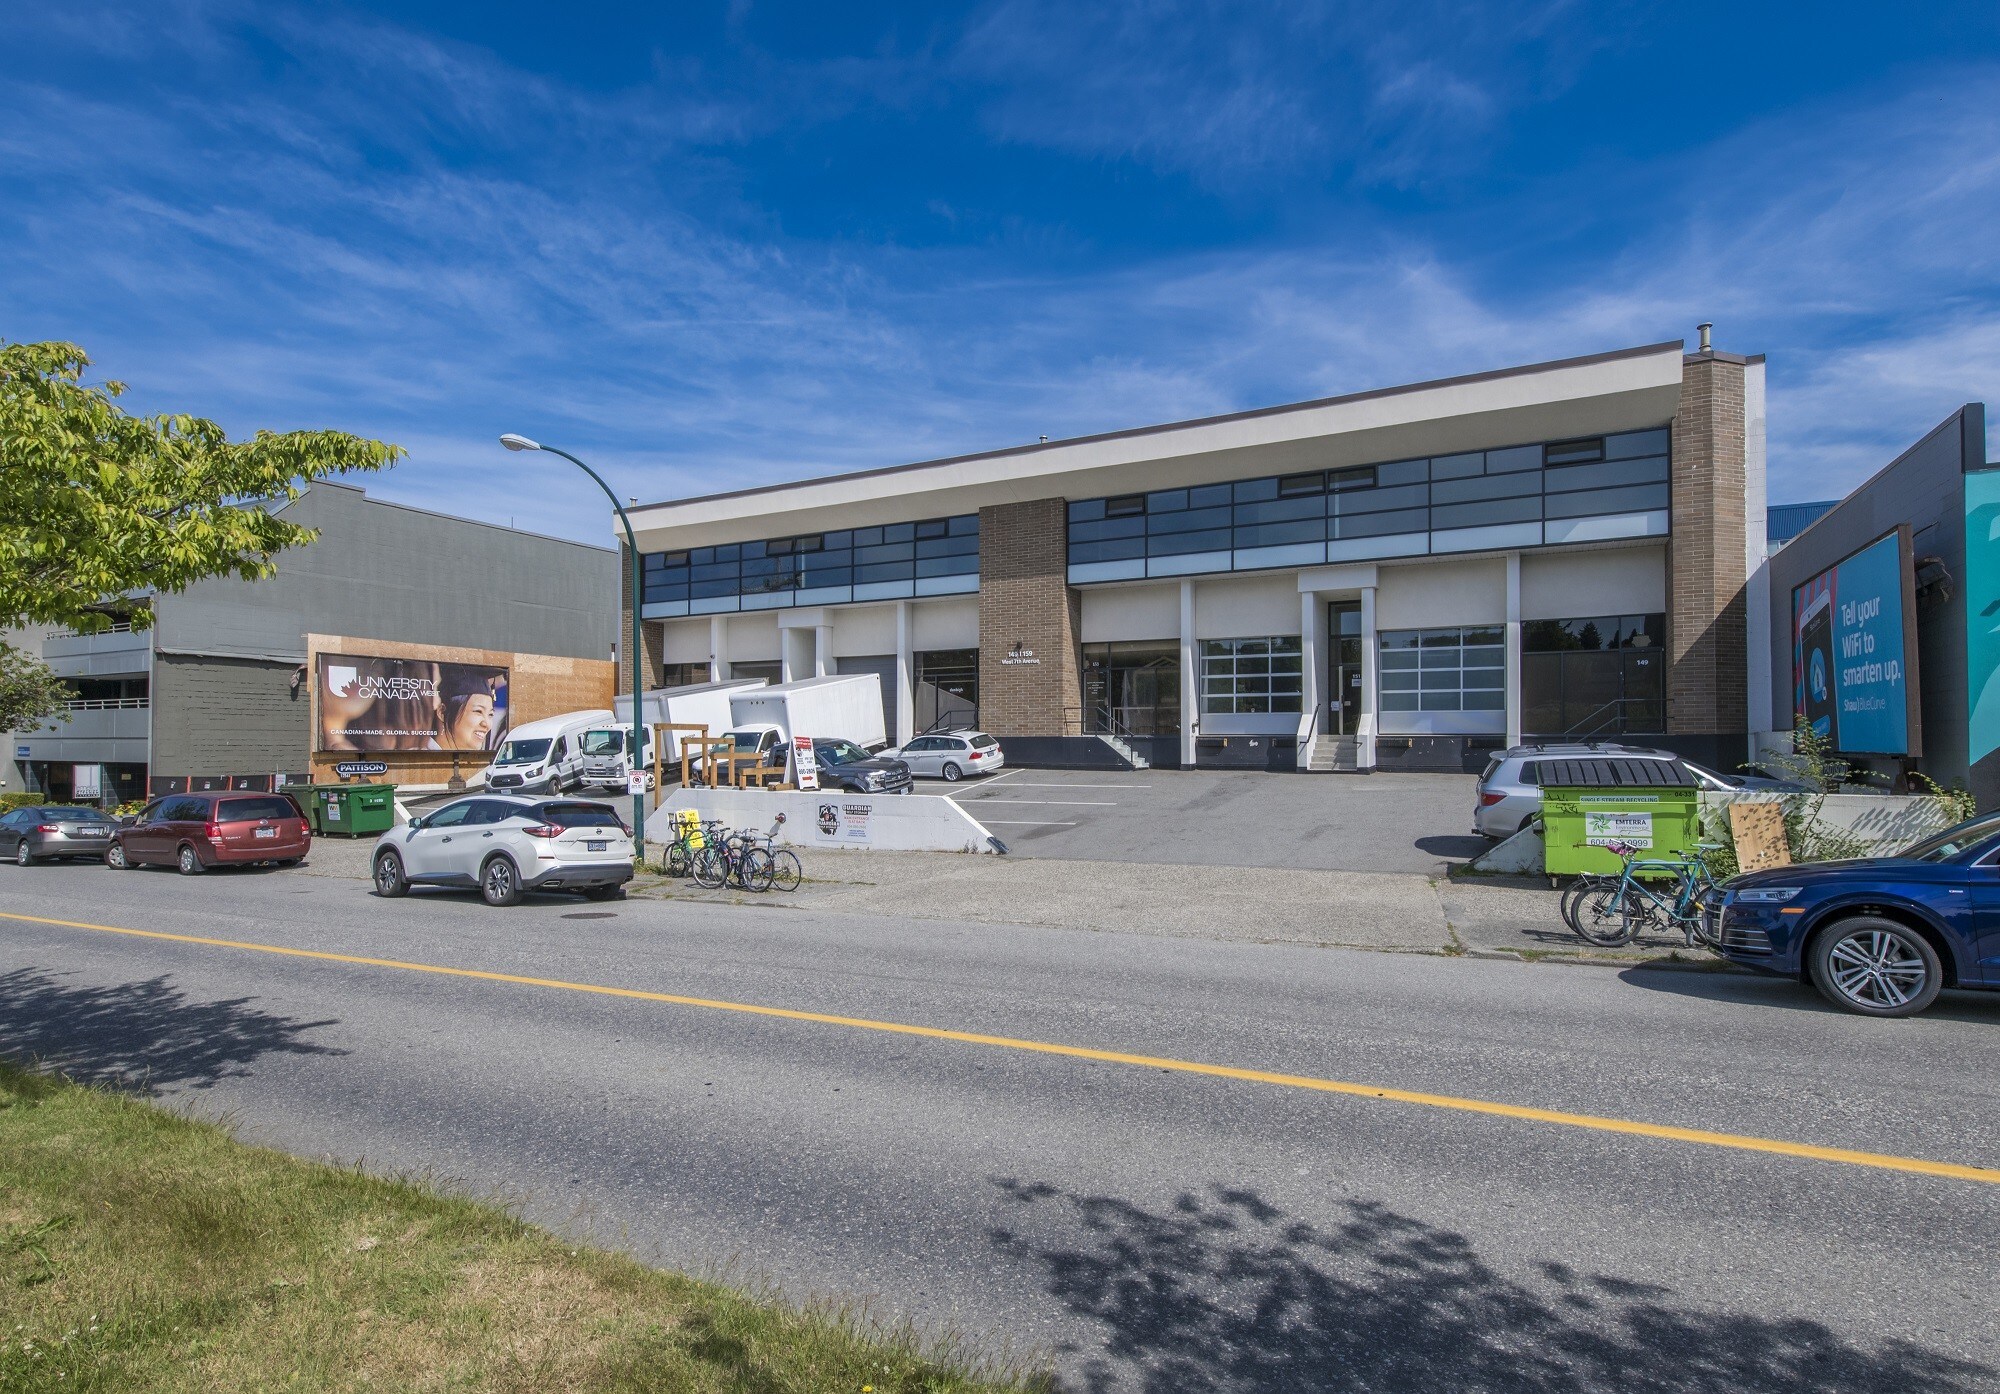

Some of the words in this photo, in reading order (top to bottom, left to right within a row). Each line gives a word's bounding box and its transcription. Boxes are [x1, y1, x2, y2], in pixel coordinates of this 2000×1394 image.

[1841, 600, 1856, 627] Tell
[1857, 596, 1880, 628] your
[1842, 632, 1862, 658] WiFi
[1863, 632, 1874, 653] to
[1843, 661, 1882, 687] smarten
[1884, 659, 1901, 686] up.
[358, 676, 438, 690] UNIVERSITY
[358, 688, 420, 700] CANADA
[340, 764, 384, 772] PATTISON
[842, 804, 873, 812] GUARDIAN
